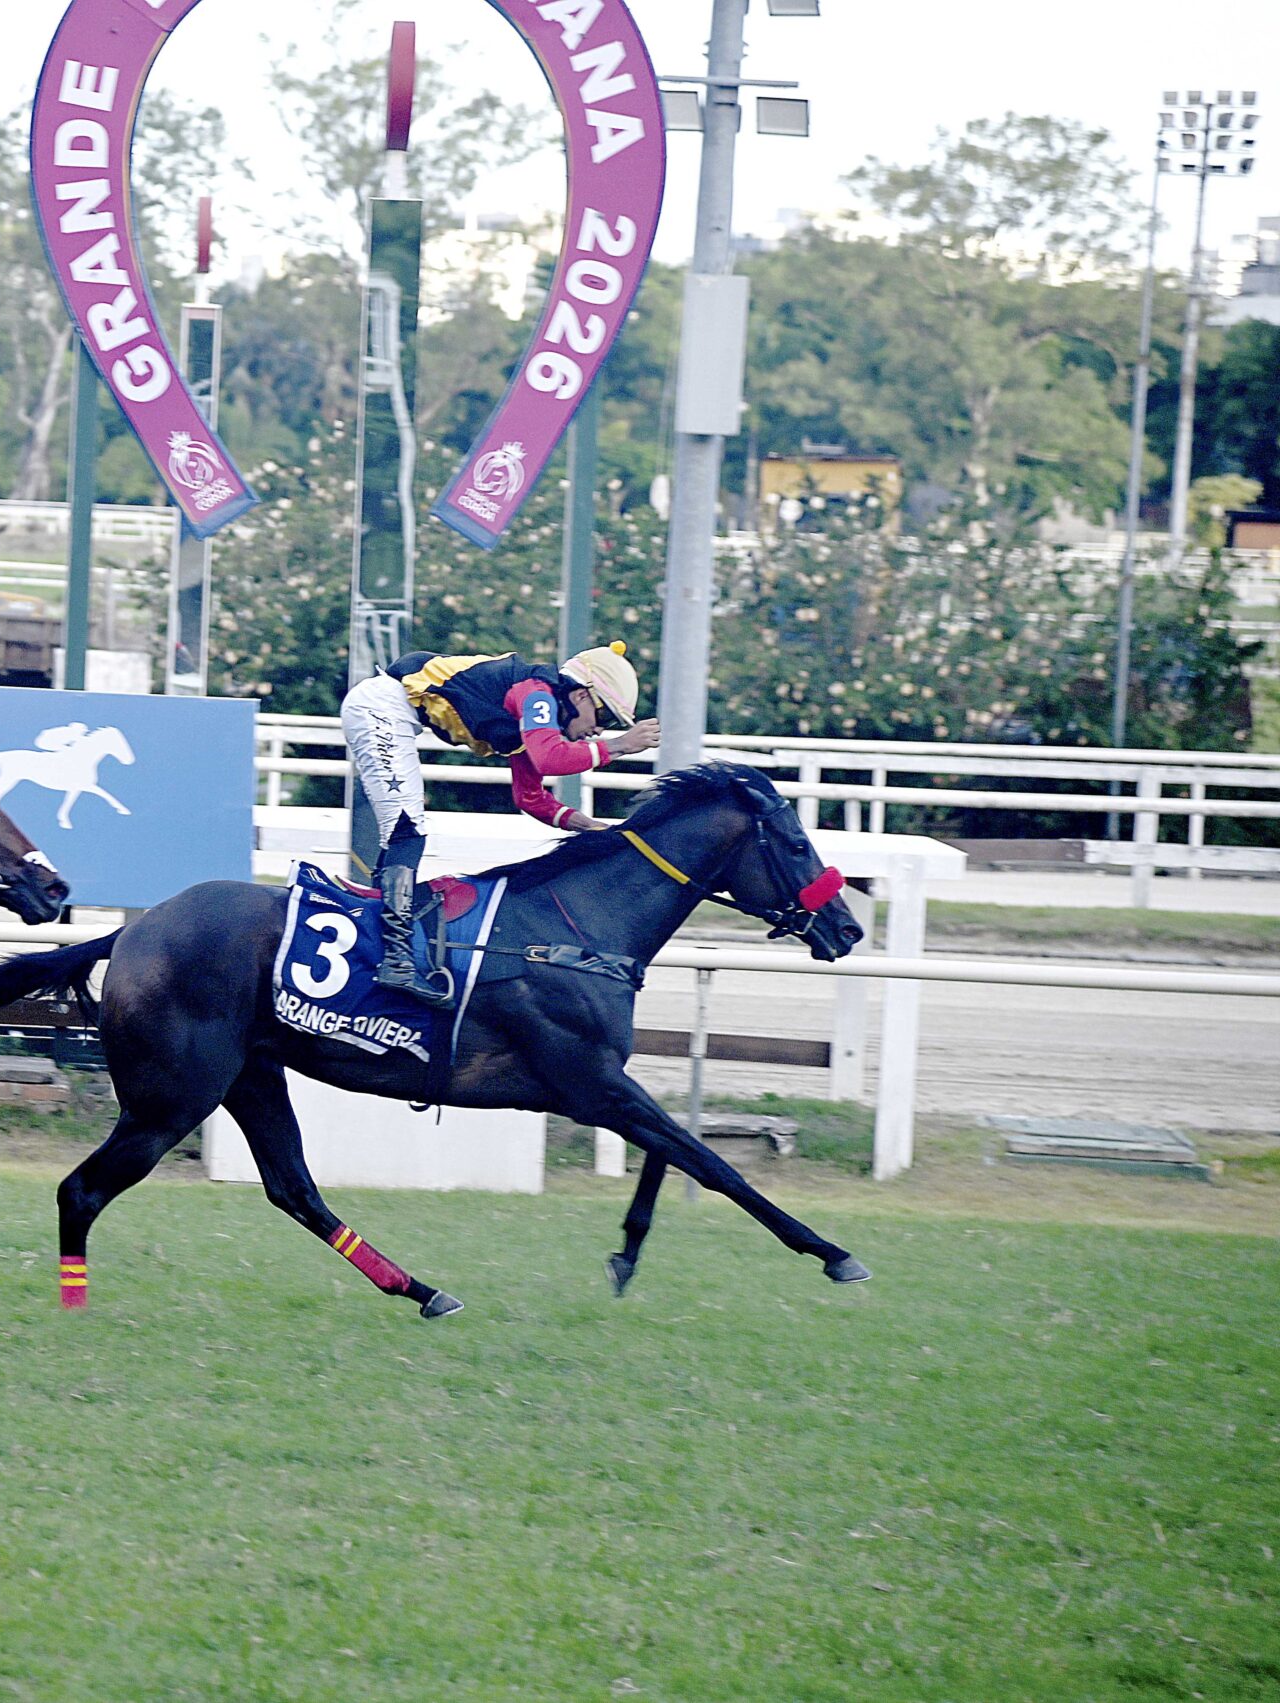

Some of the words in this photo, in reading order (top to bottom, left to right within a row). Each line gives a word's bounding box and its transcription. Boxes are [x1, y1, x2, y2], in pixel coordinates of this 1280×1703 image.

[528, 0, 646, 164] ANA
[53, 59, 171, 403] GRANDE
[525, 207, 637, 400] 2026
[532, 700, 551, 724] 3
[291, 912, 358, 999] 3
